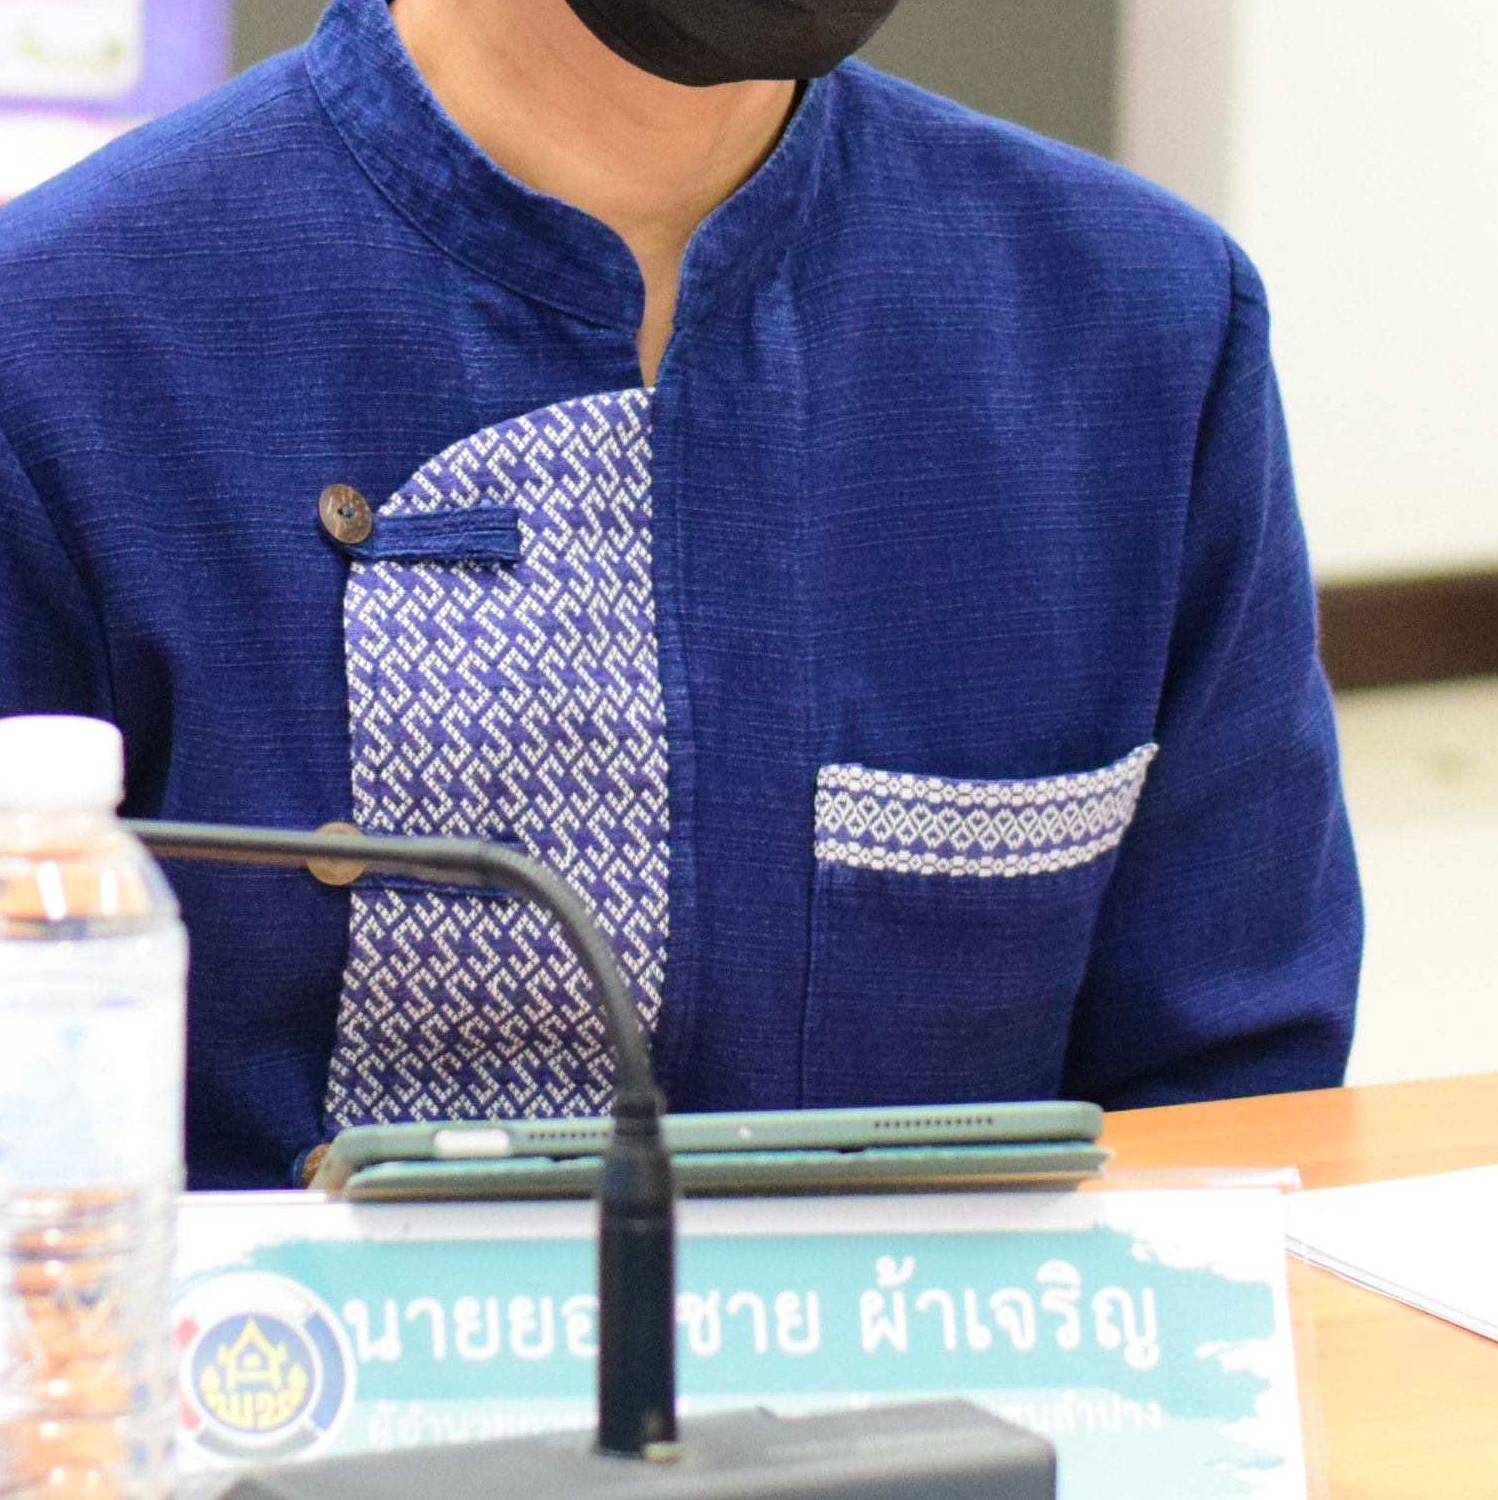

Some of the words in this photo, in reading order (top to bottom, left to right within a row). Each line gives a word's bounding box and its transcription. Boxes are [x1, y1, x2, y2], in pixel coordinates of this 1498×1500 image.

[343, 1290, 821, 1362] นายยอชาย
[860, 1256, 1161, 1371] ผ้าเจริญ
